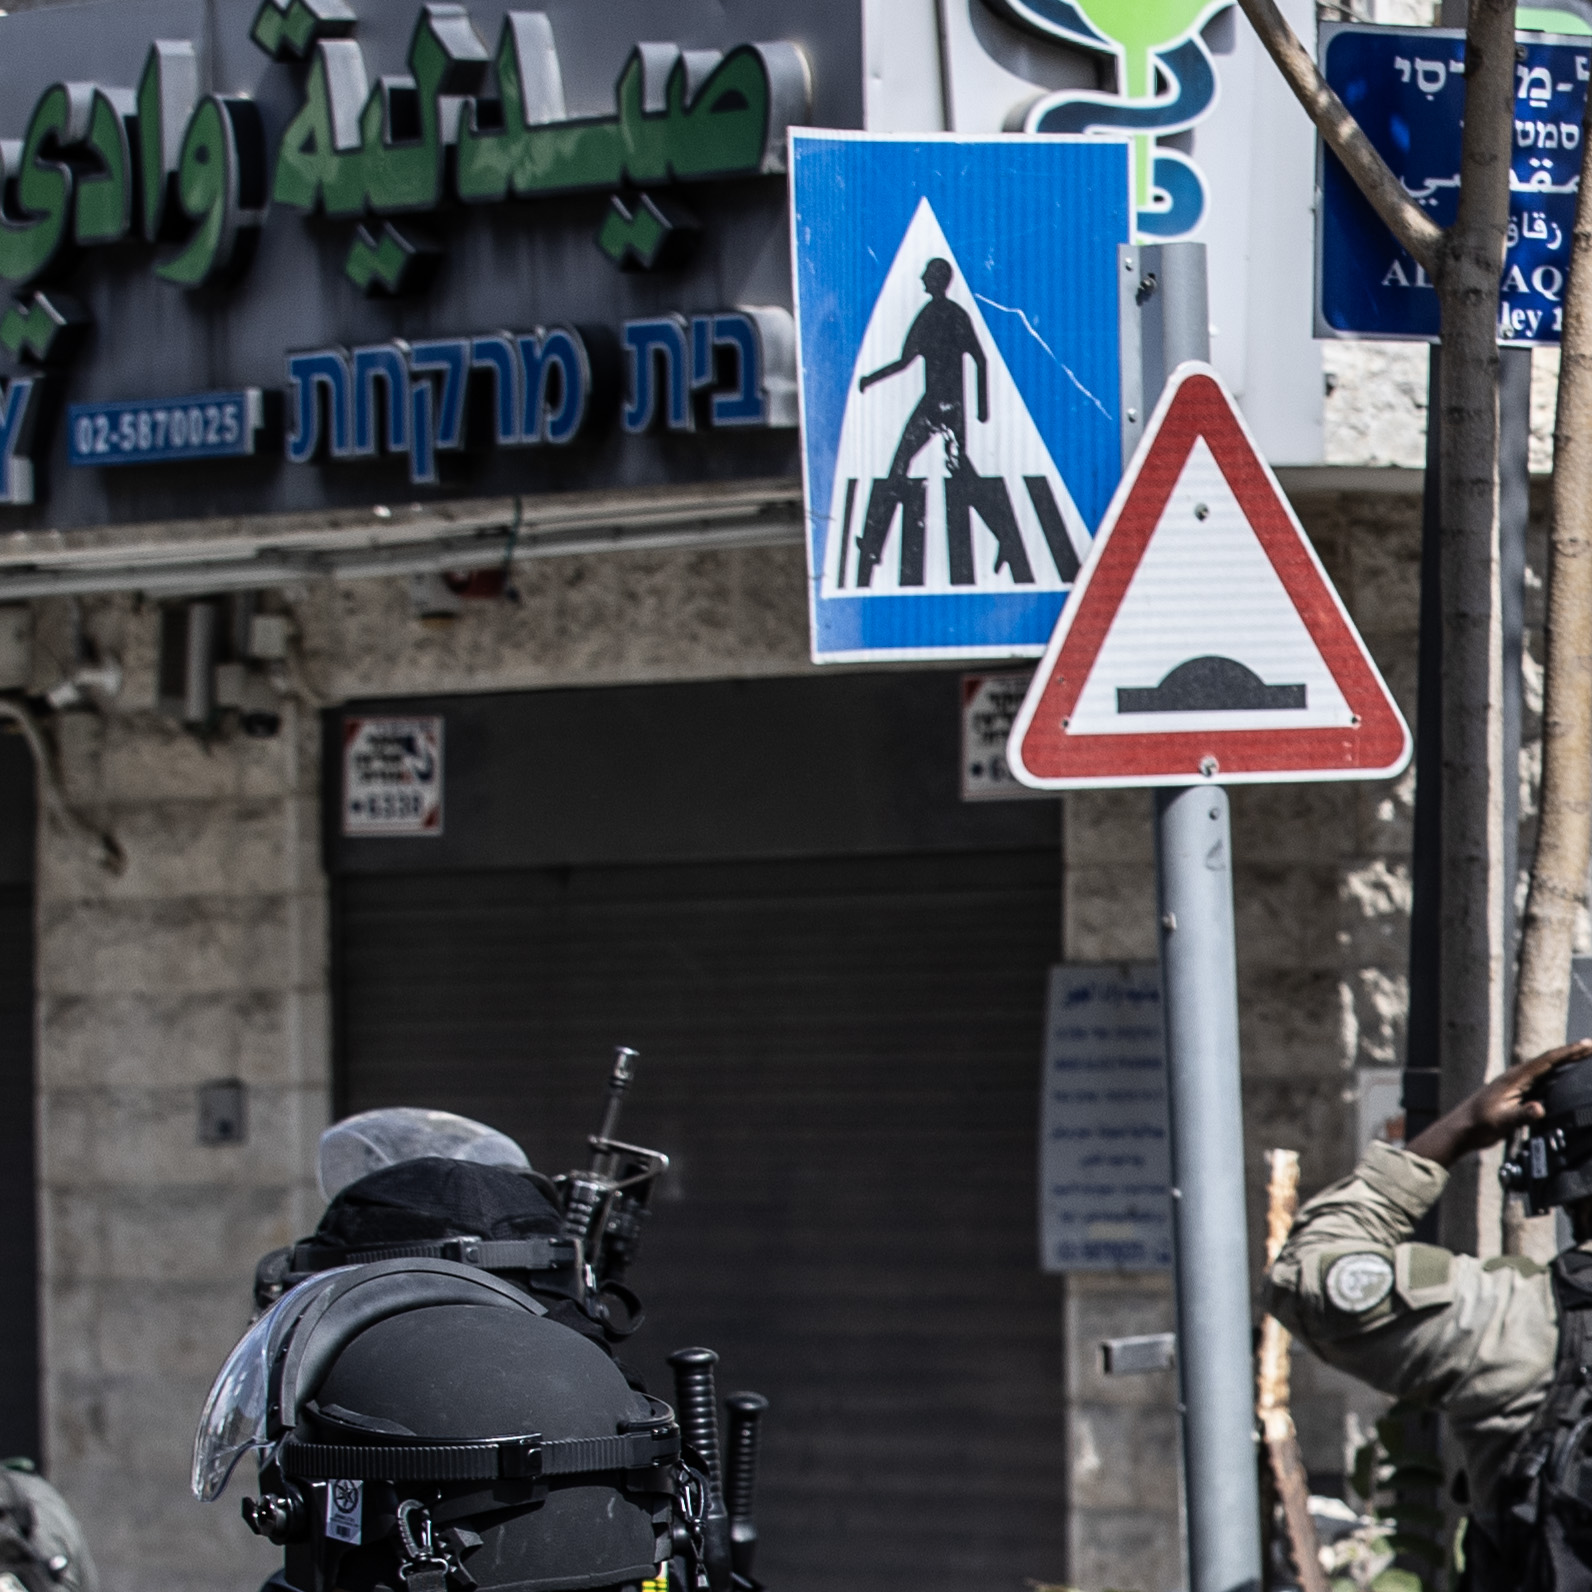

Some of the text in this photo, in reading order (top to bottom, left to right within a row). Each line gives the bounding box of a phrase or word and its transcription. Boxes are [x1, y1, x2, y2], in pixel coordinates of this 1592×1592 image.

[252, 0, 785, 295] صيدلية
[286, 311, 775, 484] בית מרקחת
[1501, 300, 1543, 338] ley
